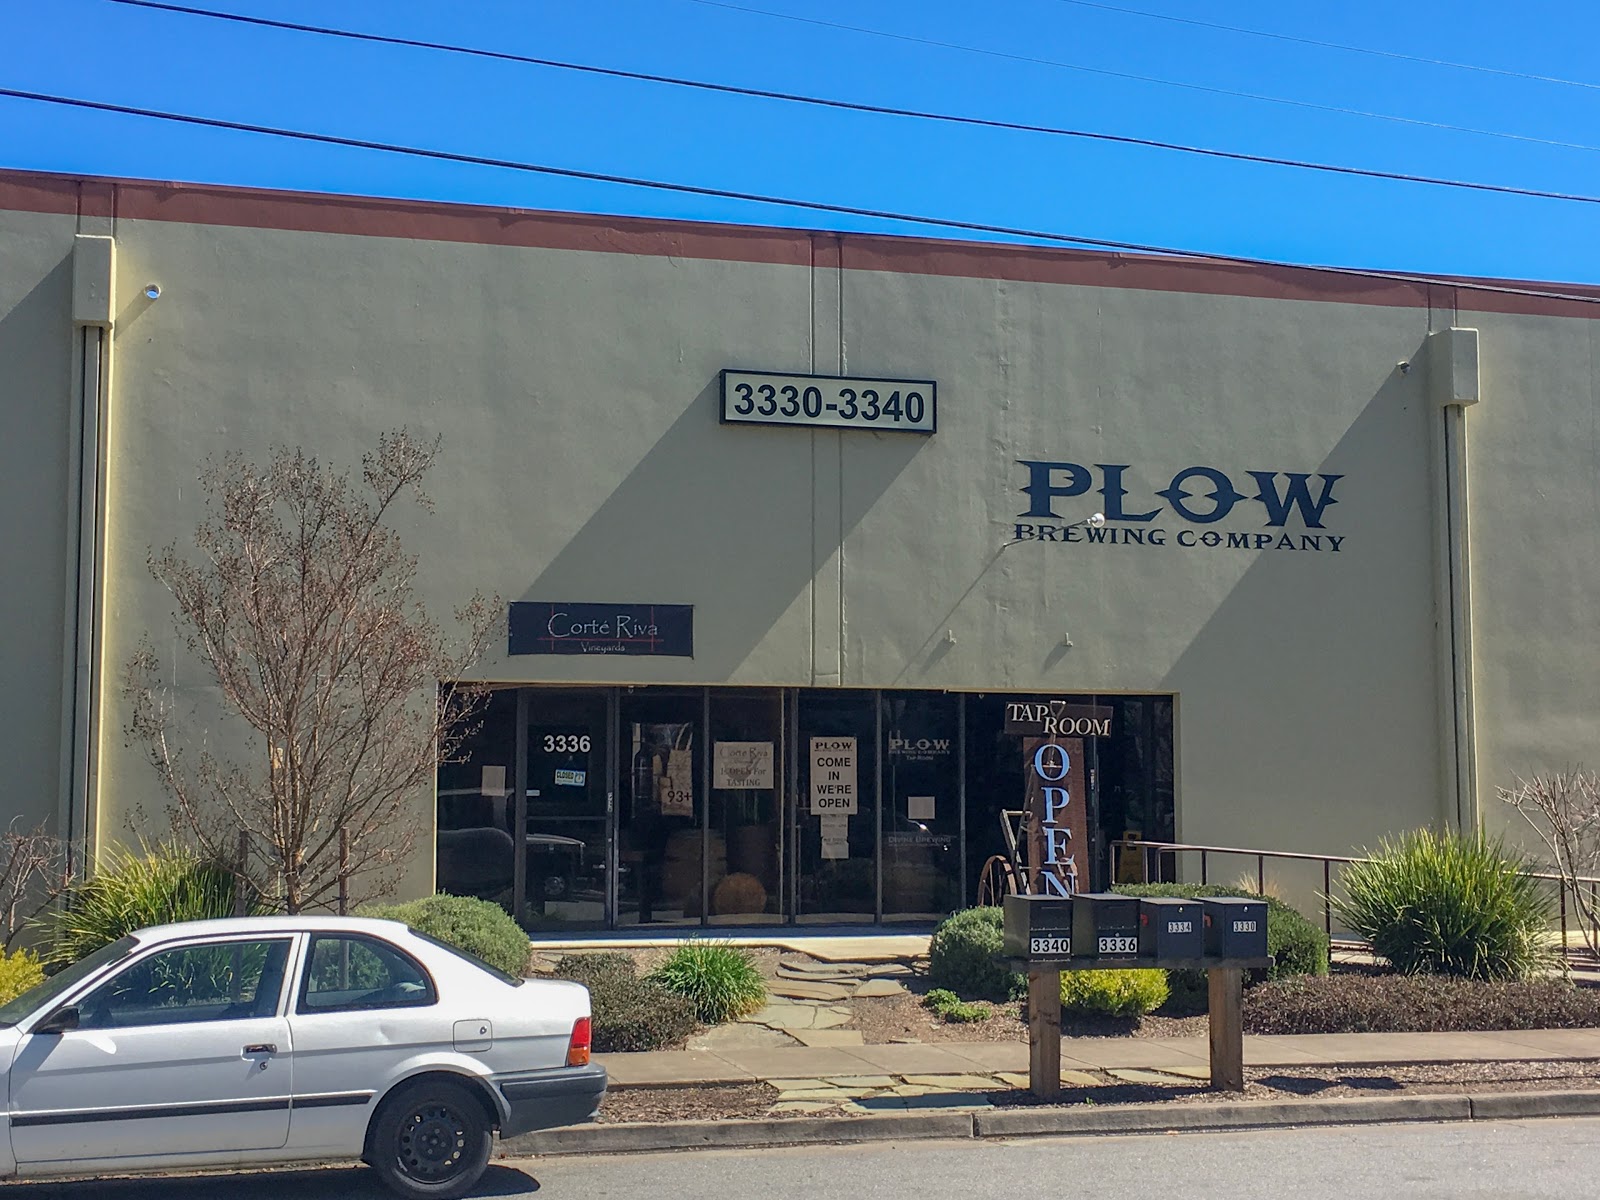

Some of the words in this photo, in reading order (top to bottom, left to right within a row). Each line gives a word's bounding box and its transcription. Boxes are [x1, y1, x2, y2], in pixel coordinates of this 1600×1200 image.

[734, 383, 925, 423] 3330-3340
[1015, 459, 1346, 529] PLOW
[1013, 523, 1166, 546] BREWING
[1176, 529, 1346, 552] COMPANY
[547, 612, 610, 638] Corté
[616, 615, 658, 639] Riva
[580, 641, 626, 654] Vineyards
[1006, 703, 1050, 722] TAP
[1042, 716, 1111, 736] ROOM
[543, 734, 591, 753] 3336
[814, 741, 853, 750] PLOW
[889, 738, 951, 750] PLOW
[817, 757, 851, 767] COME
[729, 767, 752, 775] OPEN
[753, 767, 767, 775] For
[828, 771, 840, 780] IN
[726, 778, 761, 787] TASTING
[816, 784, 852, 794] WE'RE
[667, 790, 692, 803] 93+
[818, 798, 850, 808] OPEN
[1034, 744, 1076, 899] OPEN
[1169, 922, 1191, 932] 3334
[1234, 922, 1255, 931] 3330
[1032, 938, 1070, 953] 3340
[1100, 937, 1136, 952] 3336
